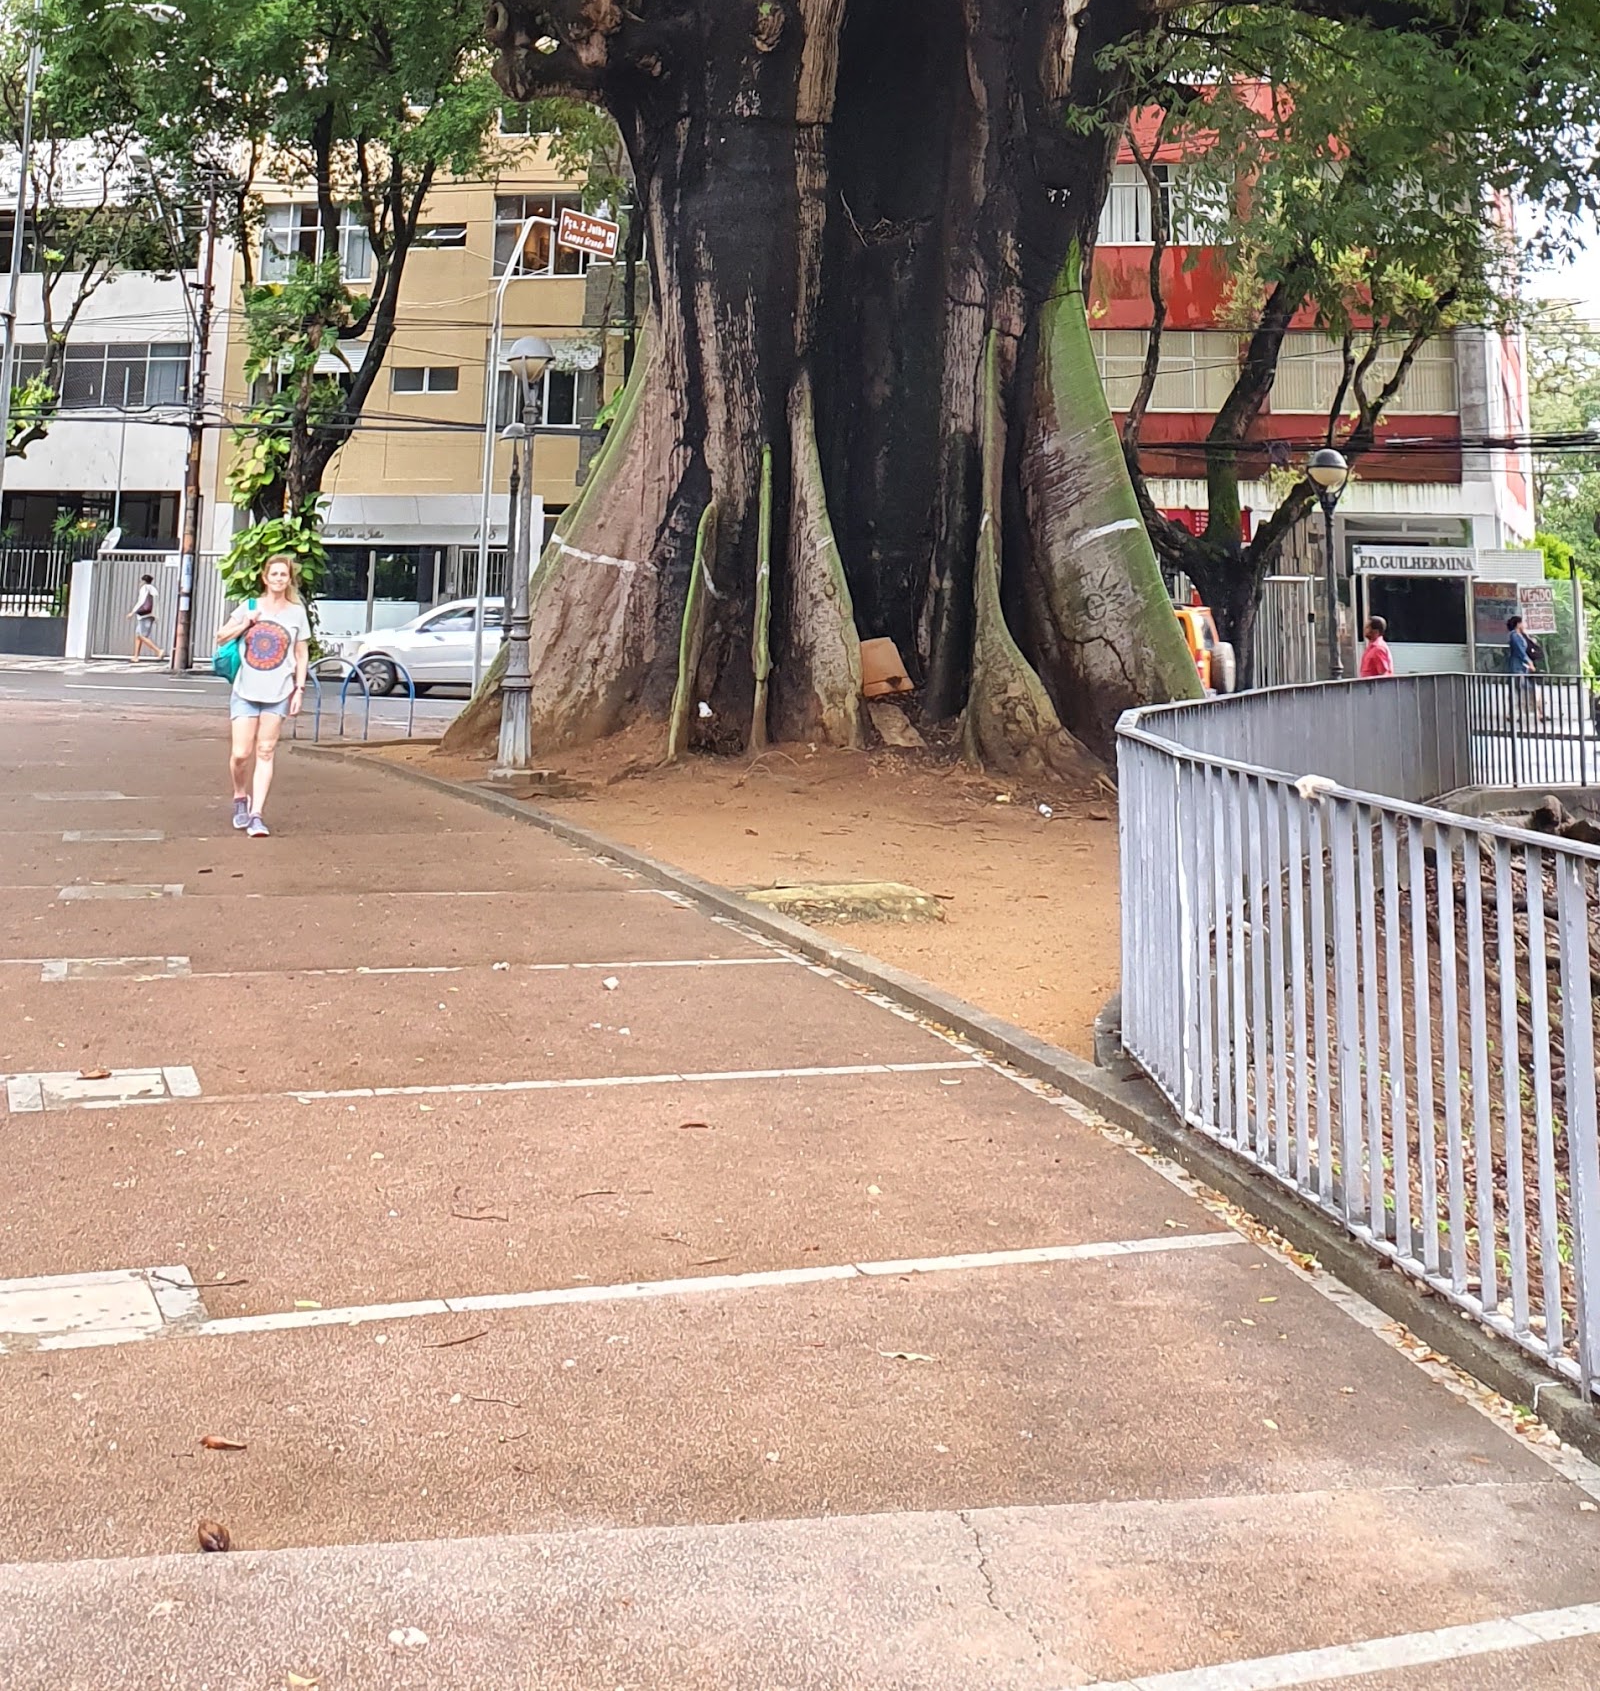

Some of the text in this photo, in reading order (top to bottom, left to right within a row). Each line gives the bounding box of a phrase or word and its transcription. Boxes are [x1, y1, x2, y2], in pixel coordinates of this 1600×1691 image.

[580, 220, 587, 231] 2
[587, 223, 606, 237] Julho
[564, 230, 604, 249] Campo Grande
[1360, 555, 1474, 570] ED. GUILHERMINA
[1521, 588, 1552, 602] VENDO
